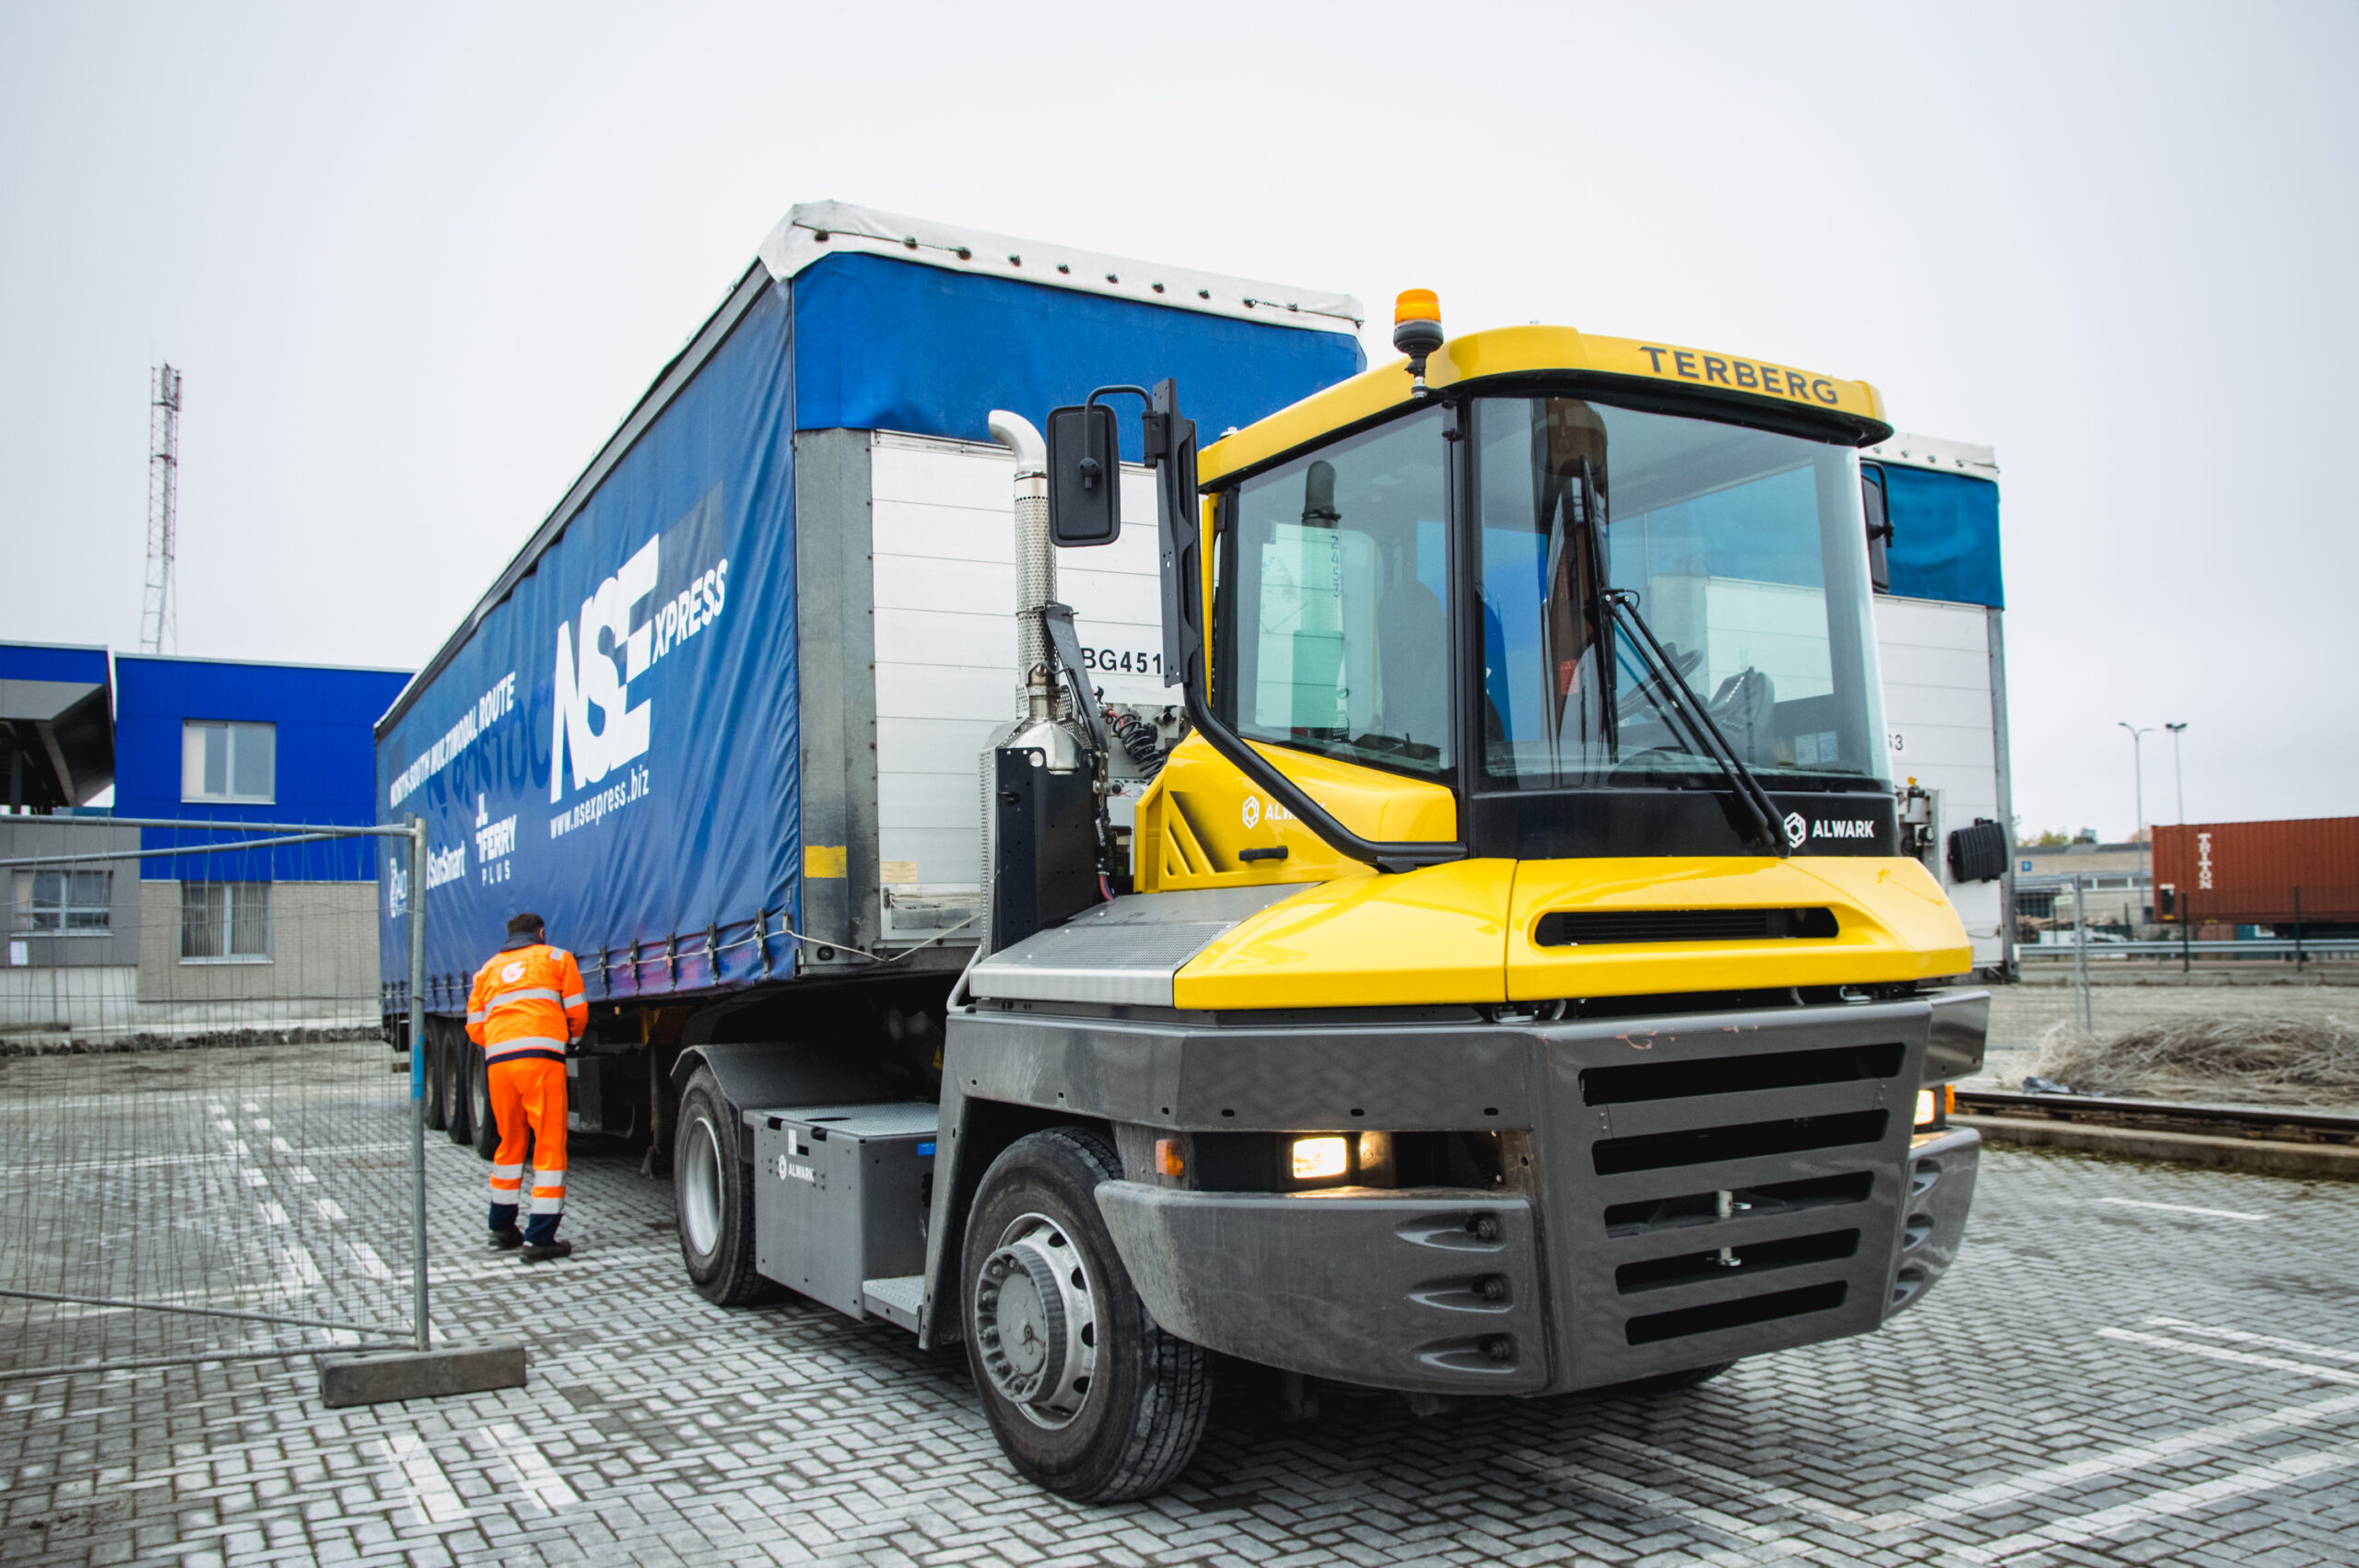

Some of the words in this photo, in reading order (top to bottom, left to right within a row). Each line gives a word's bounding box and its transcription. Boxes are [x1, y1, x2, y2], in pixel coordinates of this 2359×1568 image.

[1638, 345, 1838, 405] TERBERG
[551, 532, 660, 804] NSE
[651, 557, 729, 665] XPRESS
[1081, 647, 1162, 674] BG451
[478, 671, 516, 733] ROUTE
[550, 764, 650, 840] www.nsexpress.biz
[1812, 818, 1875, 838] ALWARK
[476, 813, 517, 863] FERRY
[2197, 833, 2213, 890] TRITON
[481, 859, 511, 887] PLUS
[788, 1163, 815, 1183] ALWARK
